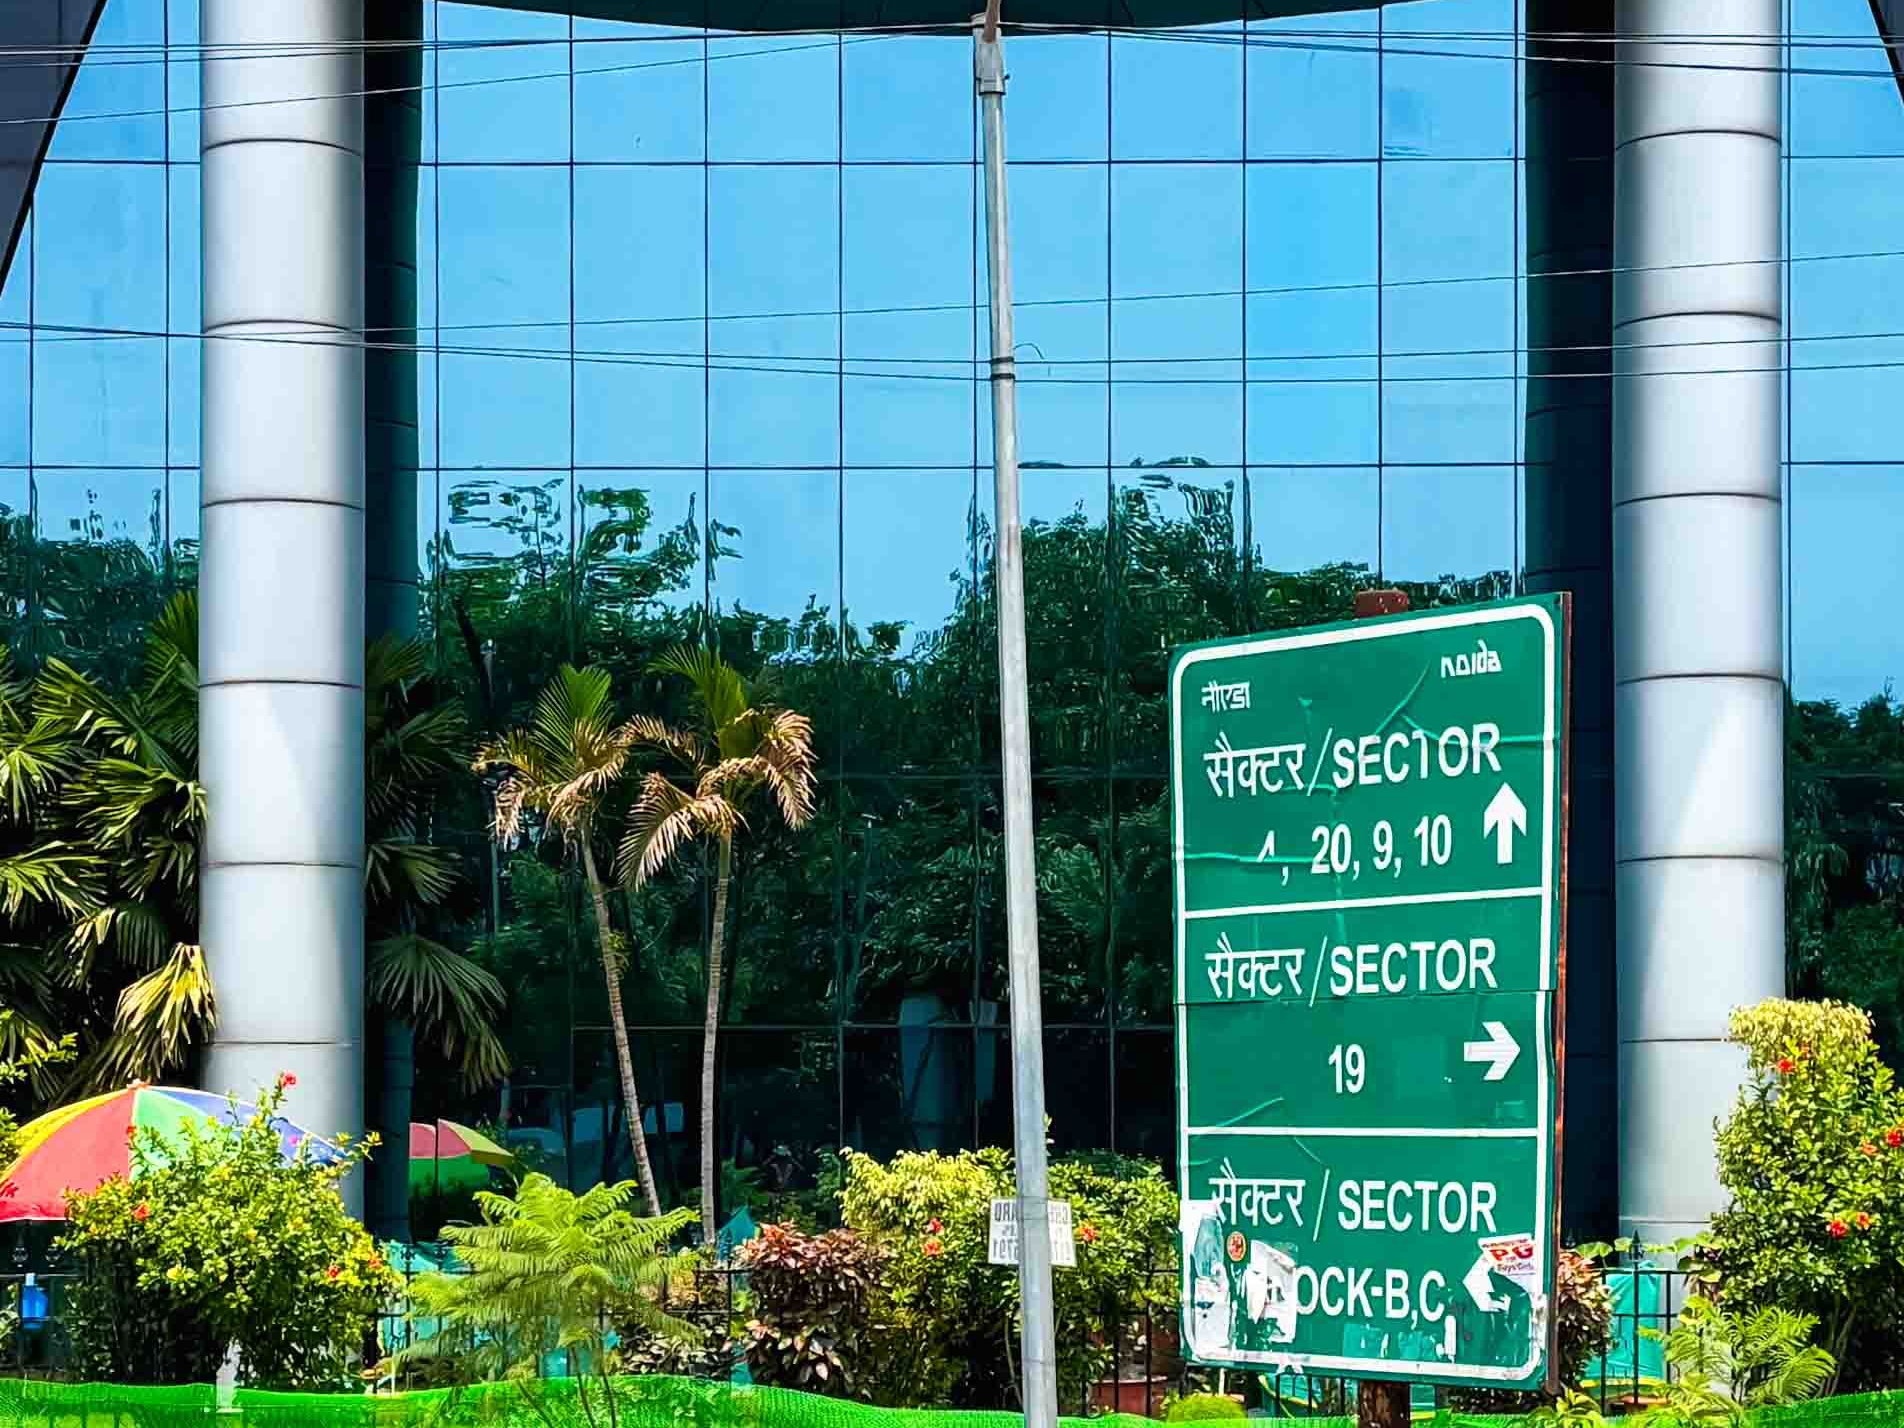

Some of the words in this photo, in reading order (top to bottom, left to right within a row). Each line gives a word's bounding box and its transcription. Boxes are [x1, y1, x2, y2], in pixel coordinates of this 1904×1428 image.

[1413, 814, 1452, 866] 10
[1328, 1043, 1366, 1094] 19
[1337, 1179, 1497, 1233] SECTOR
